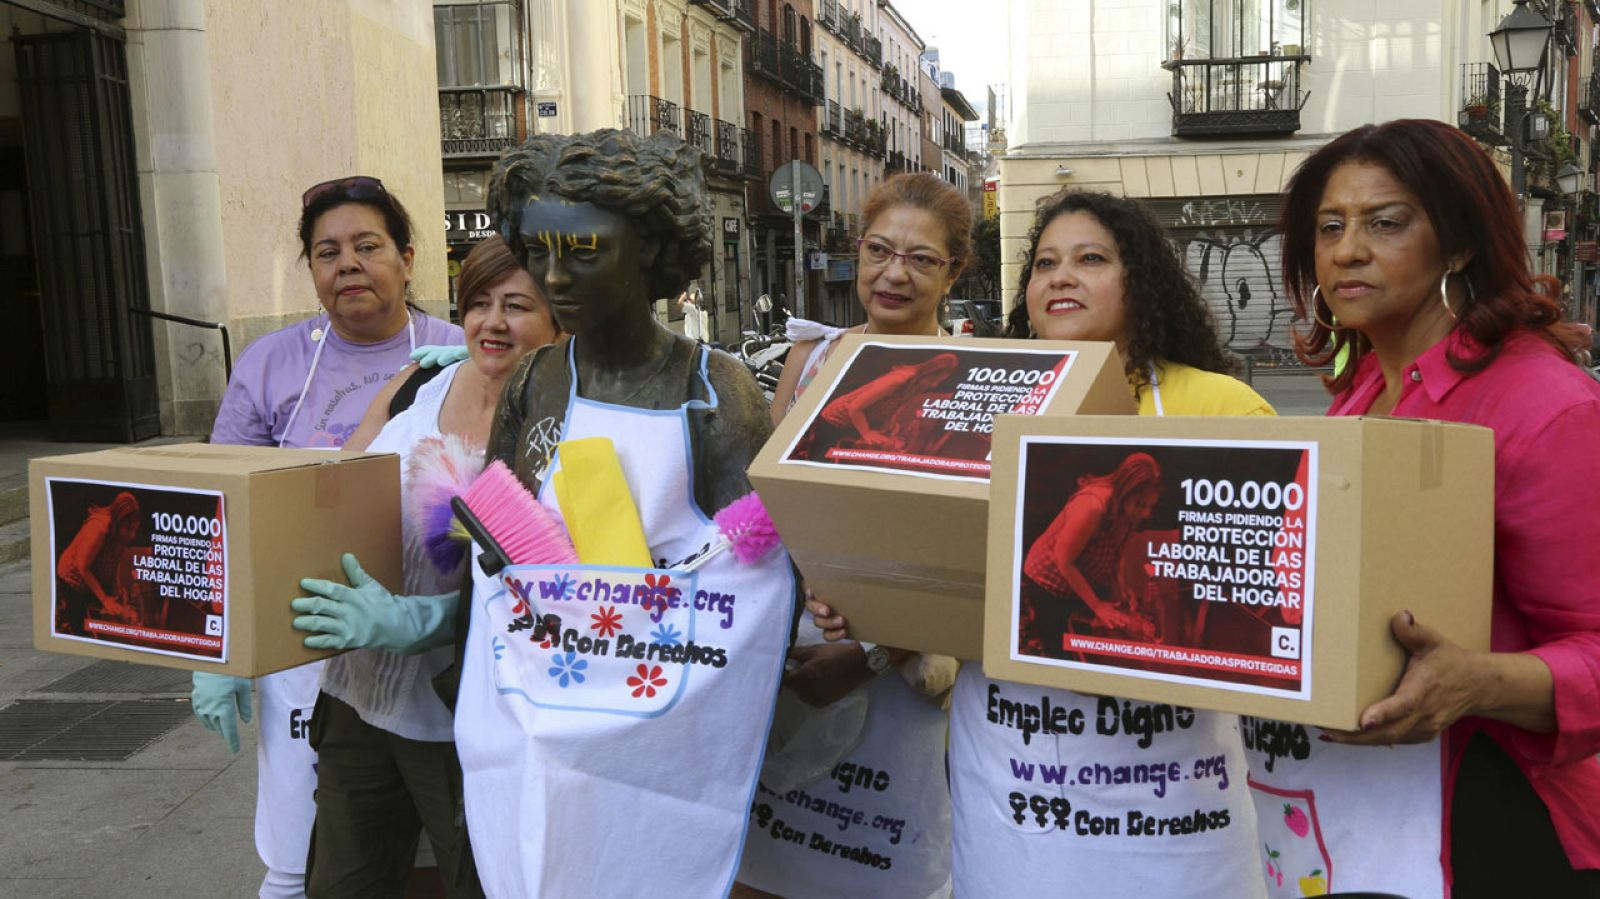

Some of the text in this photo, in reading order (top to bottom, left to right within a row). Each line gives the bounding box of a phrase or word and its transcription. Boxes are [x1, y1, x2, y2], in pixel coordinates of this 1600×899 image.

[966, 367, 1056, 386] 100.000
[954, 390, 1043, 405] PROTECCIÓN
[956, 383, 1047, 395] FIRMAS PIDIENDO LA
[922, 398, 1036, 416] LABORAL DE LAS
[922, 408, 993, 422] TRABAJAD
[944, 421, 993, 434] DEL HO
[1180, 478, 1304, 511] 100.000
[151, 512, 221, 538] 100.000
[1178, 511, 1303, 528] FIRMAS PIDIENDO LA
[151, 534, 222, 549] FIRMAS PIDIENDO LA
[1183, 526, 1302, 548] PROTECCIÓN
[154, 544, 222, 562] PROTECCIÓN
[1147, 542, 1302, 569] LABORAL DE LAS
[133, 555, 223, 577] LABORAL DE LAS
[1151, 561, 1301, 588] TRABAJADORAS
[136, 568, 223, 590] TRABAJADORAS
[159, 584, 223, 603] DEL HOGAR
[1193, 583, 1300, 609] DEL HOGAR
[563, 628, 728, 669] Con Derechos
[1278, 634, 1295, 651] C.
[1070, 637, 1298, 676] WWW.CHANGE.ORG/TRABAJADORASPROTEGIDAS
[1096, 696, 1195, 749] Digno
[830, 762, 890, 793] igno
[759, 781, 906, 845] .change.org
[1075, 809, 1231, 836] Con Derechos
[770, 819, 892, 871] Con Derechos
